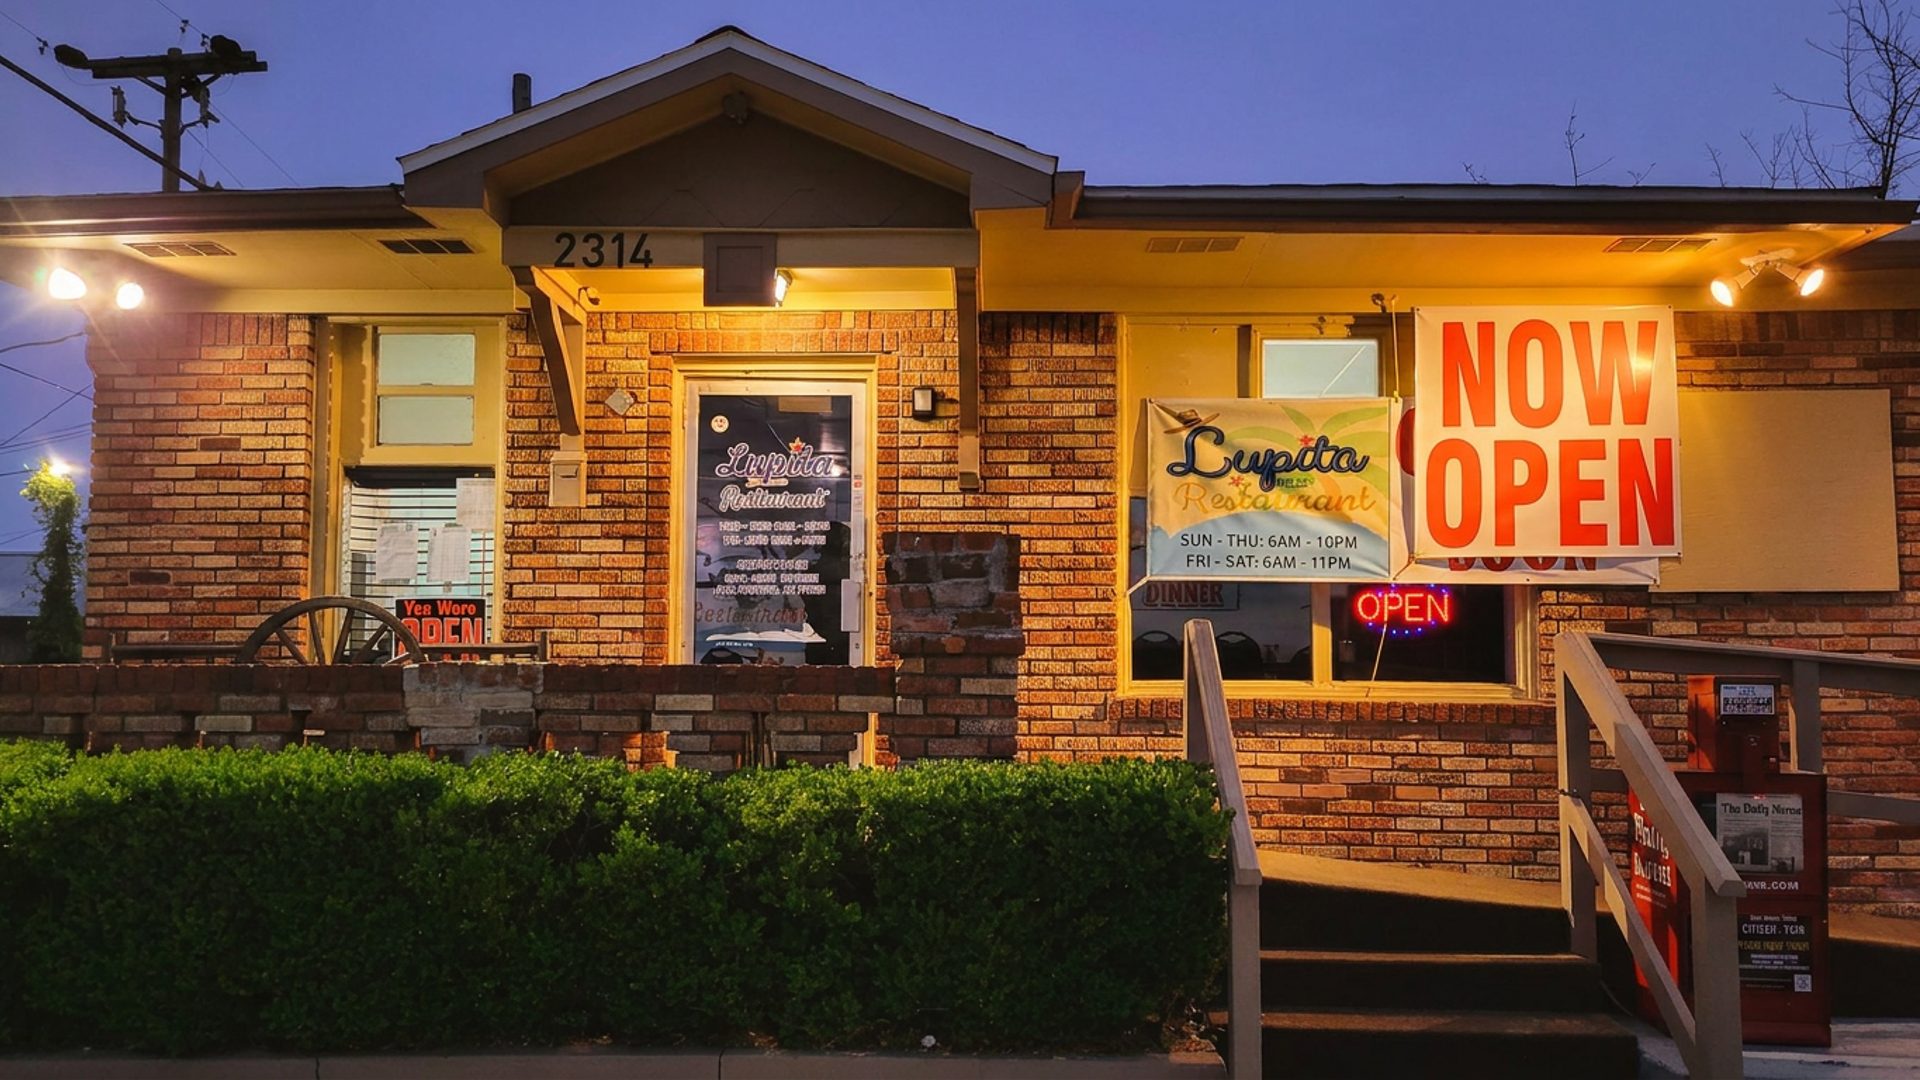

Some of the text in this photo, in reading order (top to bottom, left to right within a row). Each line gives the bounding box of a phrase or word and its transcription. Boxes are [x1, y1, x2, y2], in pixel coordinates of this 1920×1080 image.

[554, 232, 653, 268] 2314
[1442, 318, 1658, 428] NOW
[1166, 425, 1369, 491] Lupita
[1174, 482, 1377, 513] Restaurant
[1426, 438, 1675, 548] OPEN
[1180, 533, 1212, 547] SUN
[1227, 534, 1264, 547] THU:
[1268, 535, 1301, 548] 6AM
[1317, 536, 1357, 549] 10PM
[1186, 554, 1211, 568] FRI
[1226, 555, 1258, 568] SAT:
[1263, 556, 1296, 569] 6AM
[1312, 556, 1351, 570] 11PM
[1144, 582, 1224, 607] DINNER
[1357, 592, 1450, 622] OPEN
